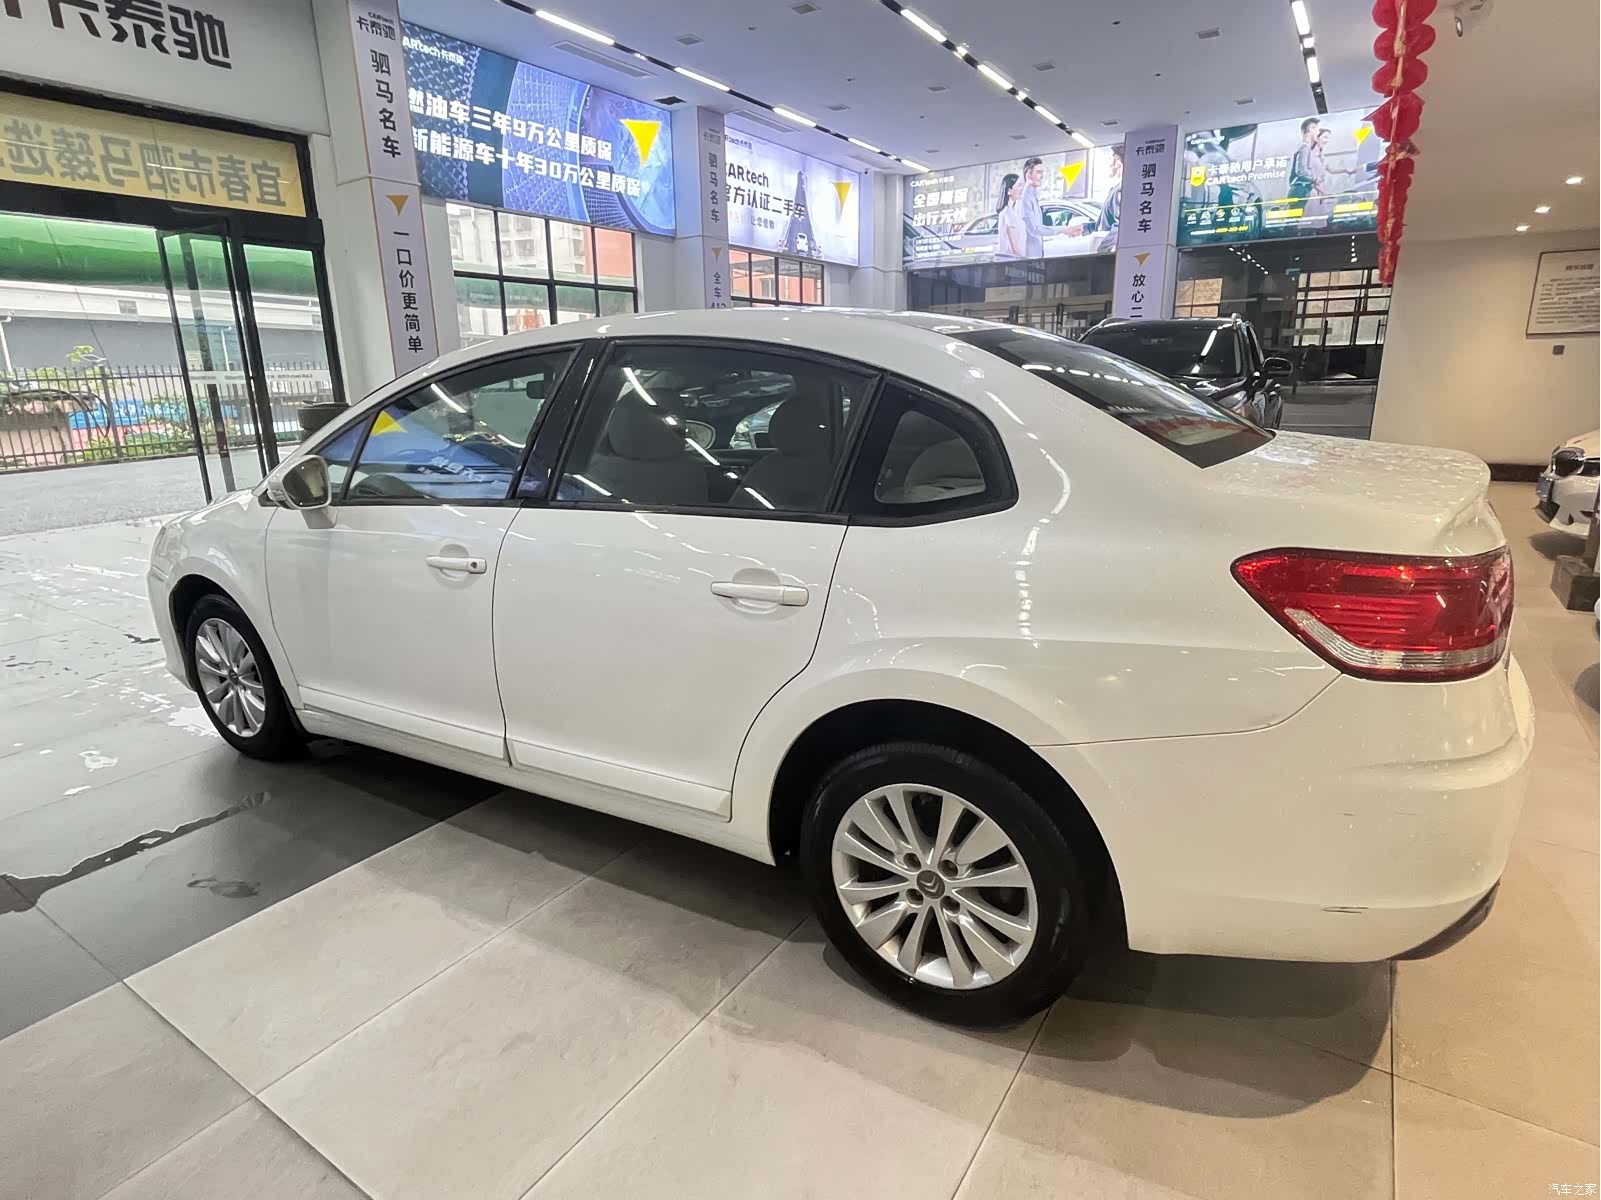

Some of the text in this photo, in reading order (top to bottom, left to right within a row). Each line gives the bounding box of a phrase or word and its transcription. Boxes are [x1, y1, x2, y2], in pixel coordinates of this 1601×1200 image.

[356, 16, 396, 41] 卡泰驰
[370, 48, 402, 160] 驷马名车
[725, 162, 770, 189] ARtech
[1247, 169, 1287, 182] Promise
[725, 184, 806, 225] 官方认证二手车
[912, 207, 969, 227] 出行无忧
[1136, 163, 1157, 234] 驷马名车
[392, 229, 425, 354] 一口价更简单
[1130, 273, 1147, 318] 放心二
